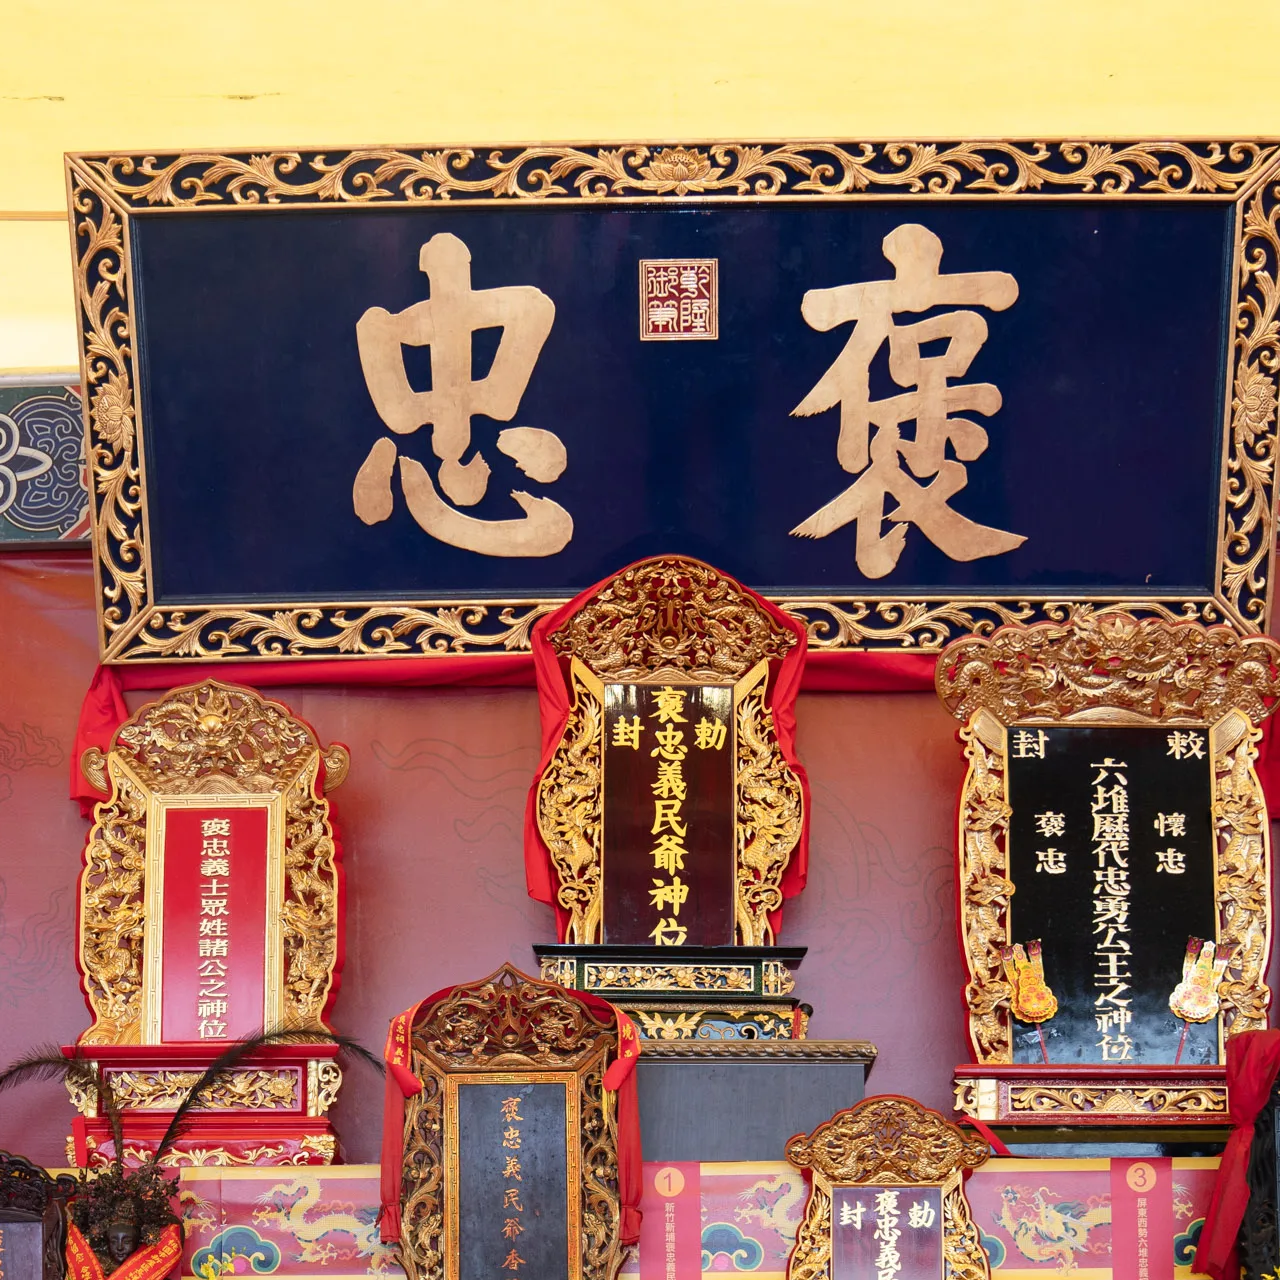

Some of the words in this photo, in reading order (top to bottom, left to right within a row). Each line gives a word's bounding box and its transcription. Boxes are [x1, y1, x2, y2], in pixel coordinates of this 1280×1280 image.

[648, 686, 690, 946] 褒忠義民爺神位
[1134, 1168, 1147, 1187] 3
